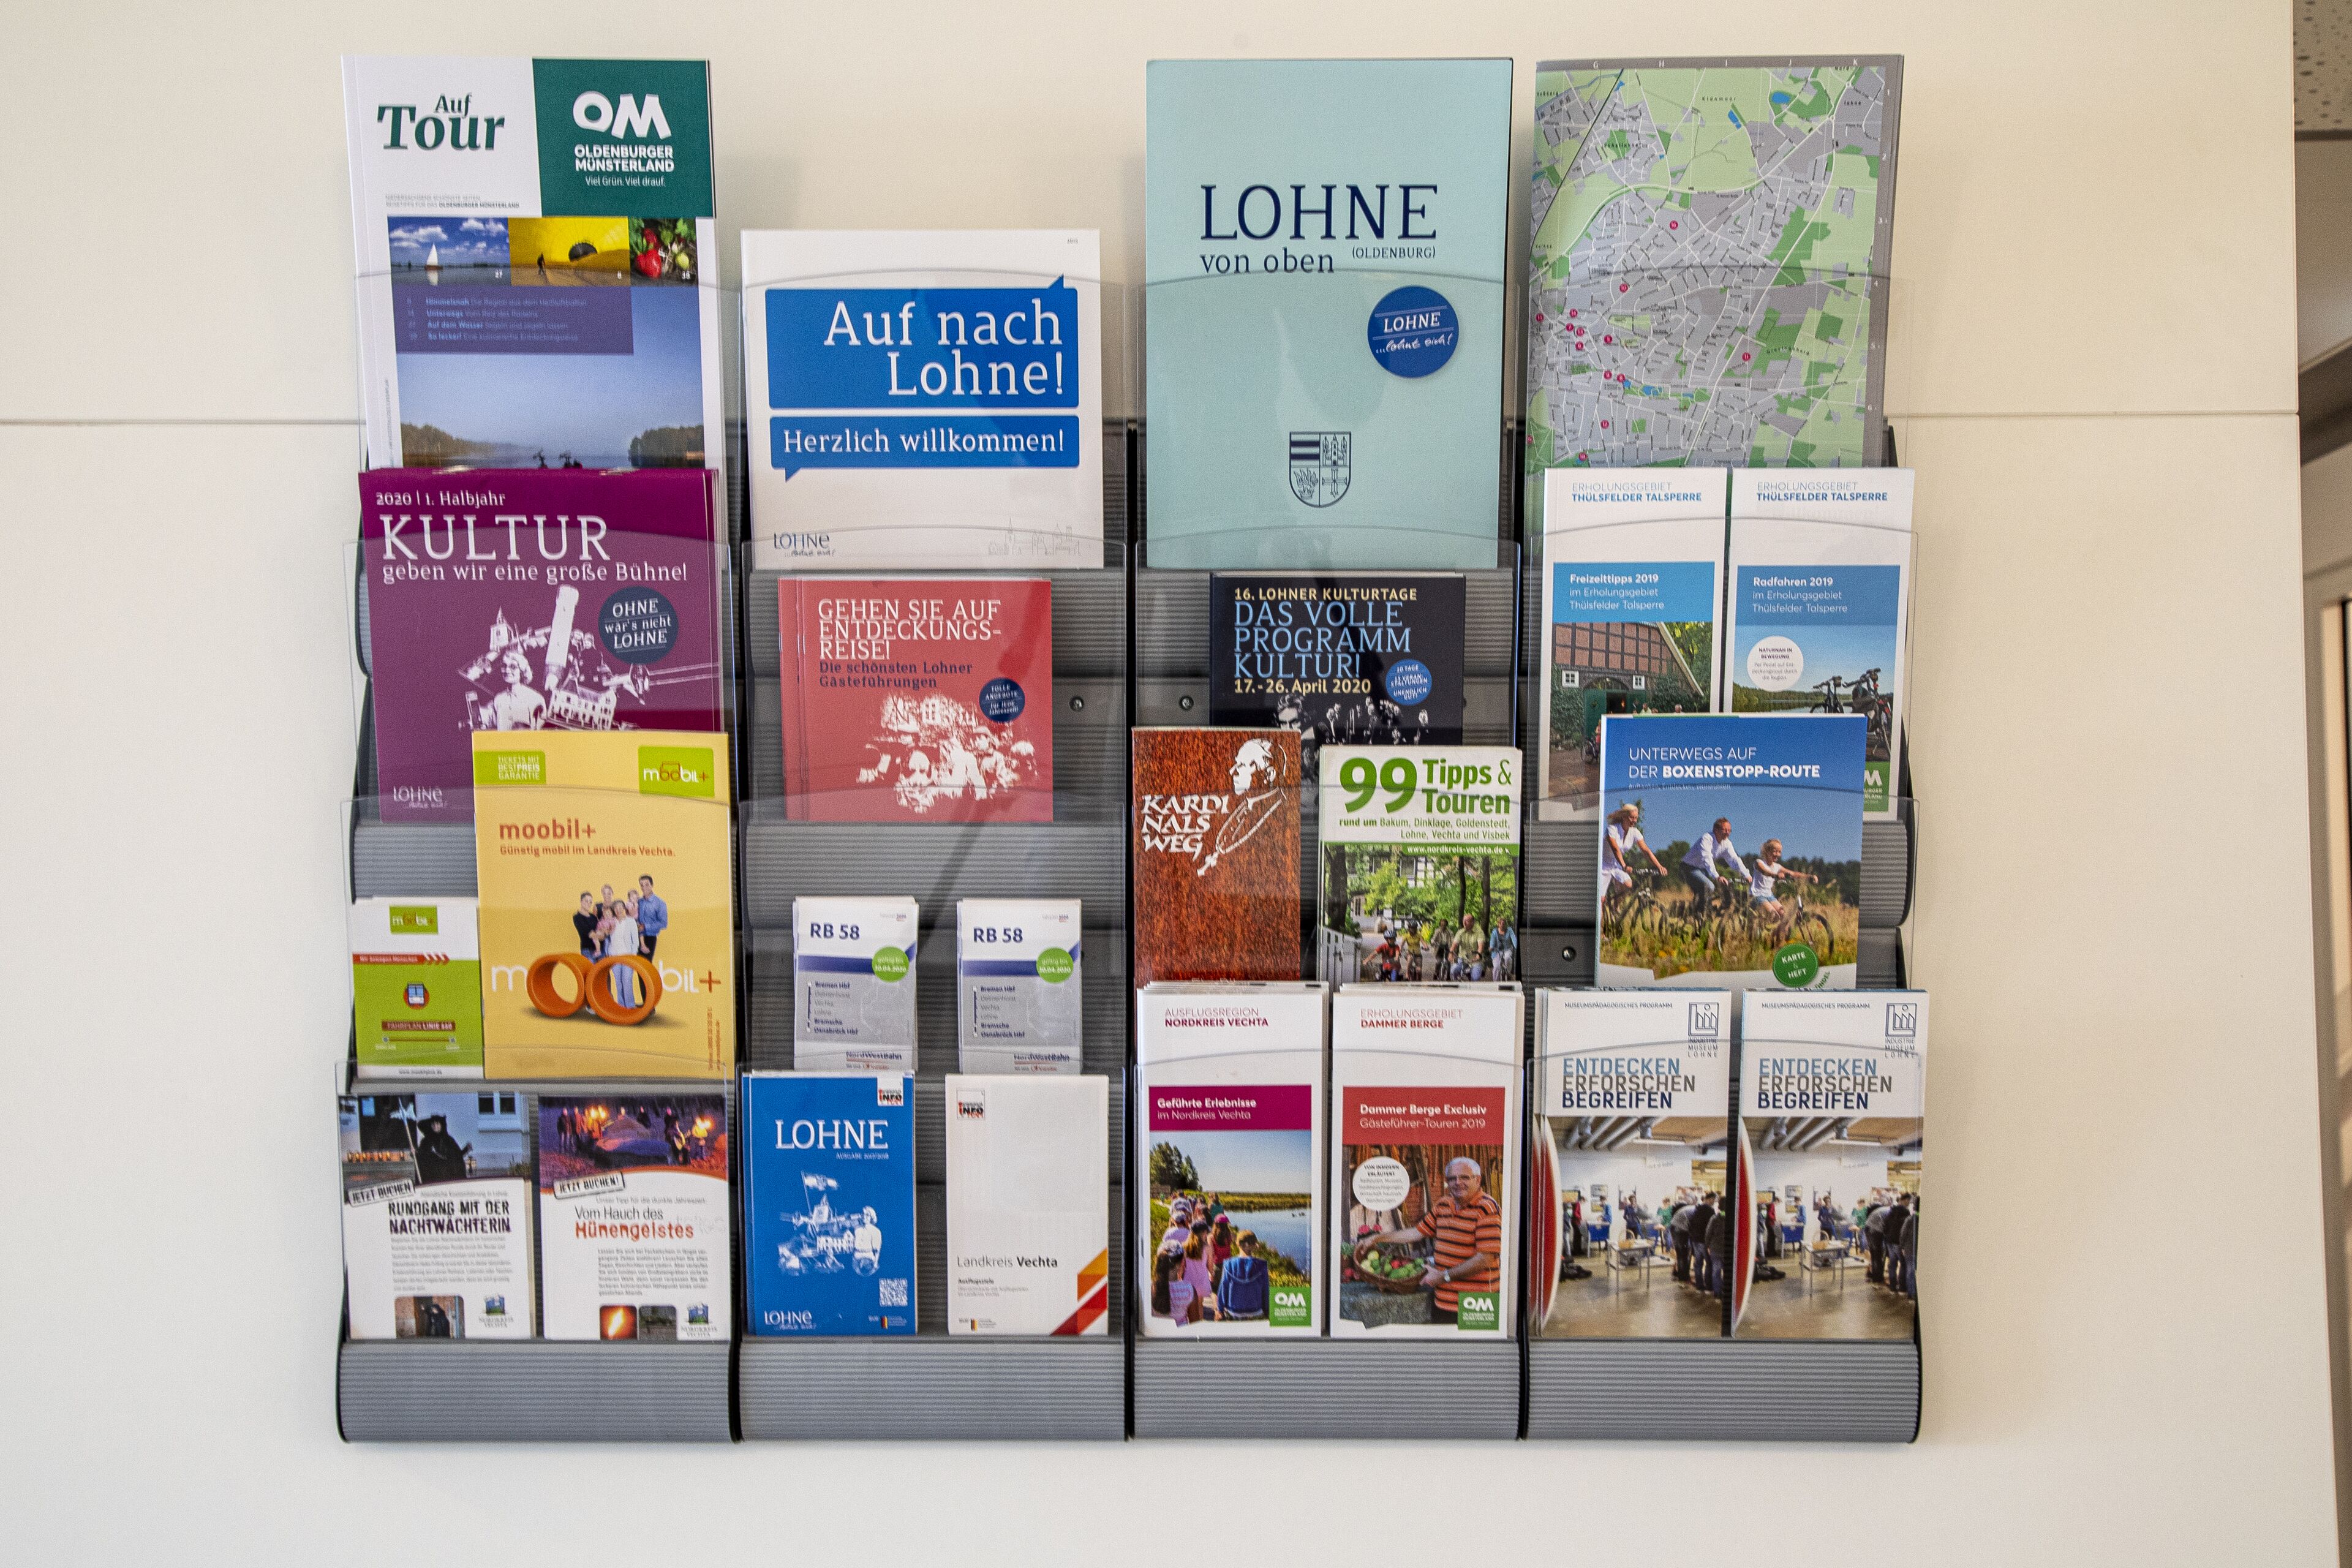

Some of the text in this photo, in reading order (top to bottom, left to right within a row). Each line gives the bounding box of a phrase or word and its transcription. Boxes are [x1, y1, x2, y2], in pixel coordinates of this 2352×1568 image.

[434, 92, 473, 118] Auf
[572, 90, 672, 140] OM
[377, 104, 505, 151] Tour
[575, 144, 673, 159] OLDENBURGER
[575, 156, 674, 172] MÜNSTERLAND
[586, 175, 665, 187] Viel Grün. Viel drauf.
[1200, 184, 1438, 240] LOHNE
[1200, 247, 1335, 274] von oben
[1352, 246, 1436, 260] (OLDENBURG)
[824, 298, 1063, 346] Auf nach
[1384, 312, 1441, 334] LOHNE
[887, 349, 1064, 396] Lohne!
[784, 428, 1064, 453] Herzlich willkommen!
[1572, 482, 1672, 492] ERHOLUNGSGEBIET
[1757, 481, 1858, 491] ERHOLUNGSGEBIET
[375, 492, 412, 506] 2020
[440, 491, 506, 509] Halbjahr
[1572, 491, 1702, 502] THÜLSFELDER TALSPERRE
[1757, 491, 1888, 502] THÜLSFELDER TALSPERRE
[379, 514, 611, 561] KULTUR
[382, 561, 687, 585] geben wir eine große Bühne!
[1570, 573, 1659, 585] Freizeittipps 2019
[1753, 576, 1834, 587] Radfahren 2019
[1235, 588, 1417, 601] 16. LOHNER KULTURTAGE
[1570, 587, 1659, 600] im Erholungsgebiet
[1753, 590, 1842, 603] im Erholungsgebiet
[612, 598, 659, 618] OHNE
[818, 598, 1001, 620] GEHEN SIE AUF
[1234, 601, 1403, 627] DAS VOLLE
[1569, 600, 1665, 612] Thülsfelder Talsperre
[1752, 603, 1848, 616] Thülsfelder Talsperre
[641, 614, 671, 630] nicht
[613, 628, 668, 649] LOHNE
[820, 620, 1002, 641] ENTDECKUNGS-
[1234, 627, 1411, 654] PROGRAMM
[820, 639, 890, 660] REISE!
[820, 661, 973, 674] Die schönsten Lohner
[1234, 653, 1361, 679] KULTUR!
[820, 676, 937, 690] Gästeführungen
[1291, 678, 1328, 696] April
[1333, 679, 1371, 694] 2020
[1629, 747, 1756, 761] UNTERWEGS AUF
[499, 772, 540, 780] GARANTIE
[1629, 764, 1820, 778] DER BOXENSTOPP-ROUTE
[1340, 757, 1512, 813] 99 Tipps &
[1141, 794, 1229, 814] KARDI
[1424, 788, 1510, 814] Touren
[499, 818, 596, 840] moobil+
[1141, 813, 1211, 834] NALS
[1340, 818, 1361, 827] rund
[1380, 818, 1410, 829] Bakum,
[1414, 818, 1452, 830] Dinklage,
[1456, 818, 1510, 830] Goldenstedt,
[1400, 829, 1510, 840] Lohne, Vechta und Visbek
[500, 845, 676, 858] Günstig mobil im Landkreis Vechta.
[1141, 833, 1204, 859] WEG
[1408, 846, 1503, 855] www.nordkreis-vechta.de
[810, 922, 860, 940] RB 58
[973, 927, 1023, 943] RB 58
[1781, 951, 1806, 963] KARTE
[1788, 968, 1807, 979] HEFT
[1165, 1008, 1259, 1017] AUSFLUGSREGION
[1361, 1009, 1463, 1019] ERHOLUNGSGEBIET
[1165, 1017, 1268, 1027] NORDKREIS VECHTA
[1361, 1019, 1444, 1029] DAMMER BERGE
[1563, 1058, 1680, 1076] ENTDECKEN
[1759, 1058, 1877, 1076] ENTDECKEN
[1562, 1075, 1695, 1092] ERFORSCHEN
[1758, 1076, 1892, 1093] ERFORSCHEN
[1157, 1098, 1257, 1109] Geführte Erlebnisse
[1562, 1091, 1672, 1109] BEGREIFEN
[1758, 1091, 1869, 1109] BEGREIFEN
[1158, 1110, 1251, 1120] im Nordkreis Vechta
[1360, 1104, 1487, 1117] Dammer Berge Exclusiv
[1360, 1118, 1485, 1129] Gästeführer-Touren 2019
[775, 1119, 889, 1150] LOHNE
[560, 1180, 581, 1193] JETZT
[389, 1200, 510, 1216] RUNDGANG MIT DER
[575, 1205, 663, 1221] Vom Hauch des
[390, 1216, 511, 1234] NACHTWÄCHTERIN
[576, 1221, 694, 1242] Hünengeistes
[957, 1255, 1058, 1268] Landkreis Vechta
